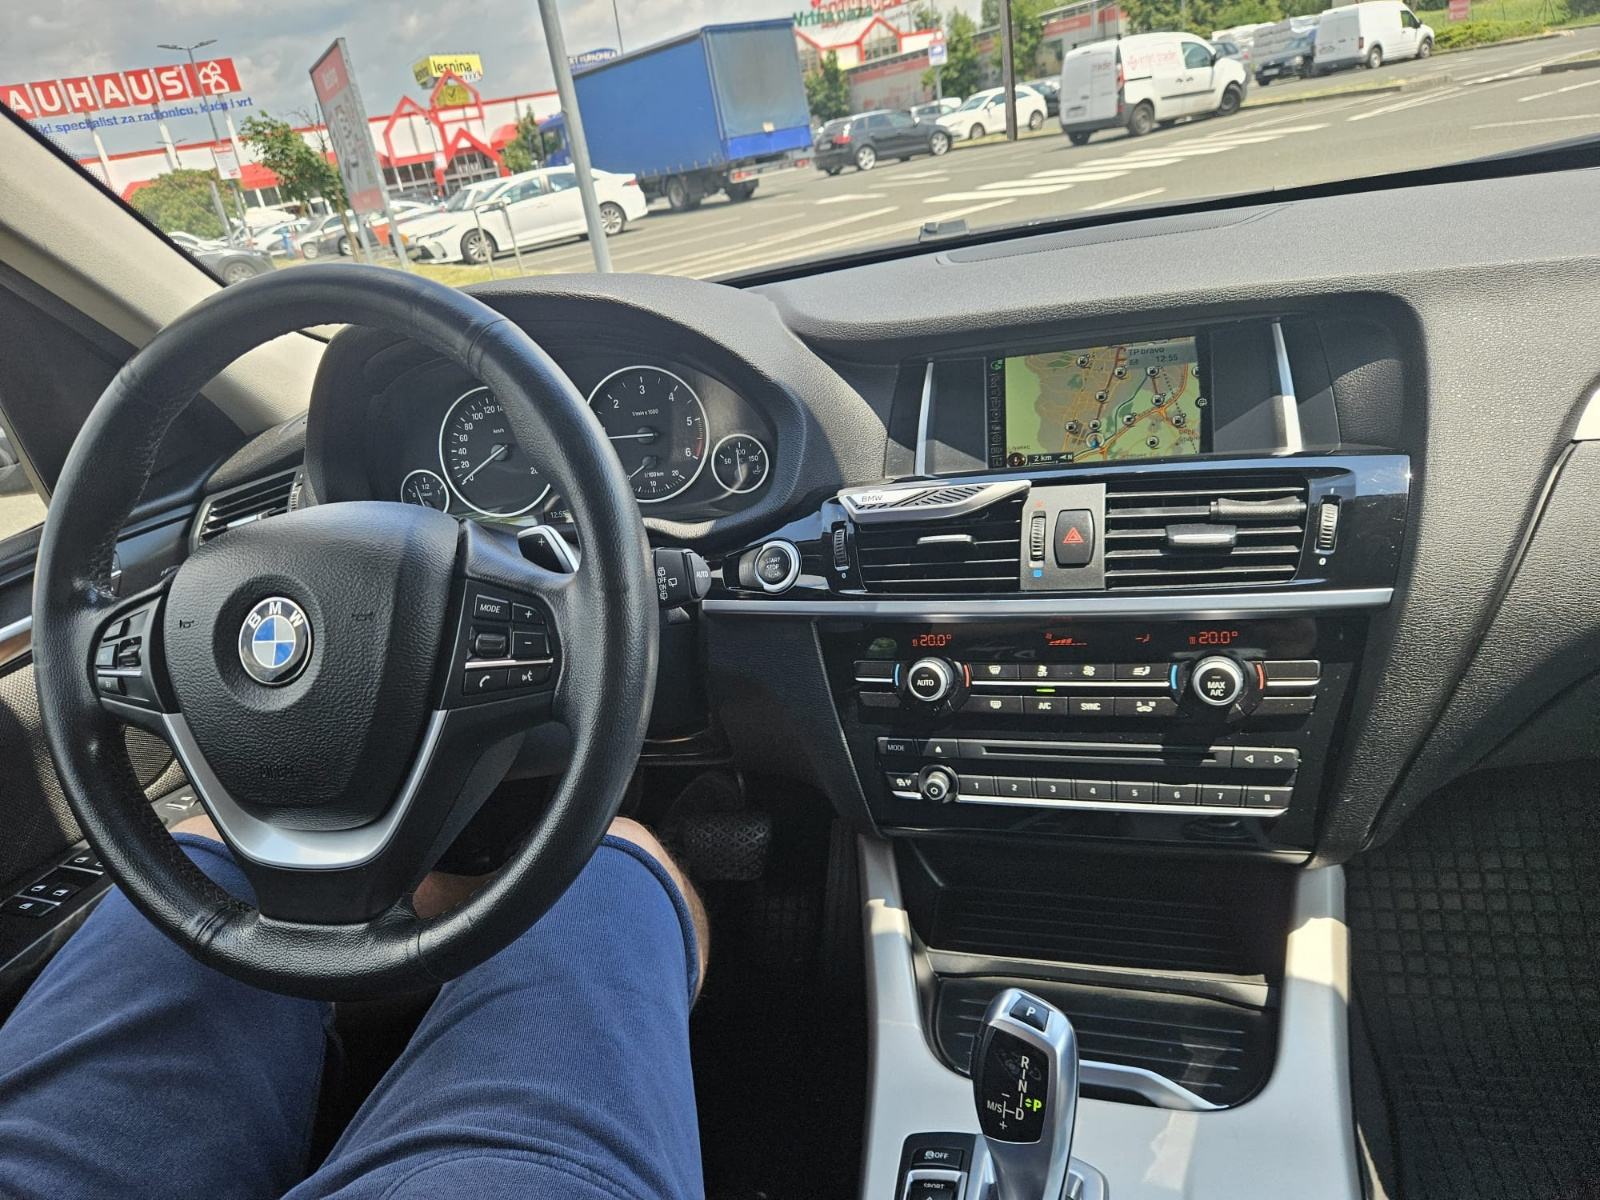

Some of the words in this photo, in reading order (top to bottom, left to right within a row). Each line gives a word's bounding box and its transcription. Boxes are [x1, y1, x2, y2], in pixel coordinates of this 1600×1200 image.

[7, 69, 184, 115] AUHAUS
[121, 114, 136, 124] za
[236, 96, 254, 108] vrt
[639, 385, 646, 395] 3
[668, 391, 675, 402] 4
[613, 400, 620, 409] 2
[483, 405, 496, 414] 120
[471, 412, 484, 421] 100
[686, 416, 693, 426] 5
[464, 422, 473, 431] 80
[459, 434, 468, 442] 60
[458, 447, 467, 455] 40
[685, 448, 692, 457] 6
[461, 460, 470, 469] 20
[861, 494, 883, 503] BMW
[696, 570, 709, 578] AUTO
[480, 603, 501, 614] MODE
[248, 601, 304, 630] BMW
[916, 679, 935, 687] AUTO
[1207, 681, 1226, 690] MAX
[1210, 689, 1224, 697] A/C
[1038, 702, 1052, 710] A/C
[1081, 702, 1101, 711] SYNC
[887, 743, 905, 752] MODE
[1050, 785, 1056, 793] 3
[1090, 787, 1096, 795] 4
[1131, 789, 1138, 797] 5
[1217, 792, 1224, 800] 7
[1026, 1006, 1036, 1017] P
[1021, 1055, 1030, 1070] R
[1018, 1079, 1027, 1093] N
[986, 1100, 1003, 1114] M/S
[1033, 1099, 1042, 1112] P
[1015, 1107, 1024, 1121] D
[934, 1151, 950, 1159] OFF
